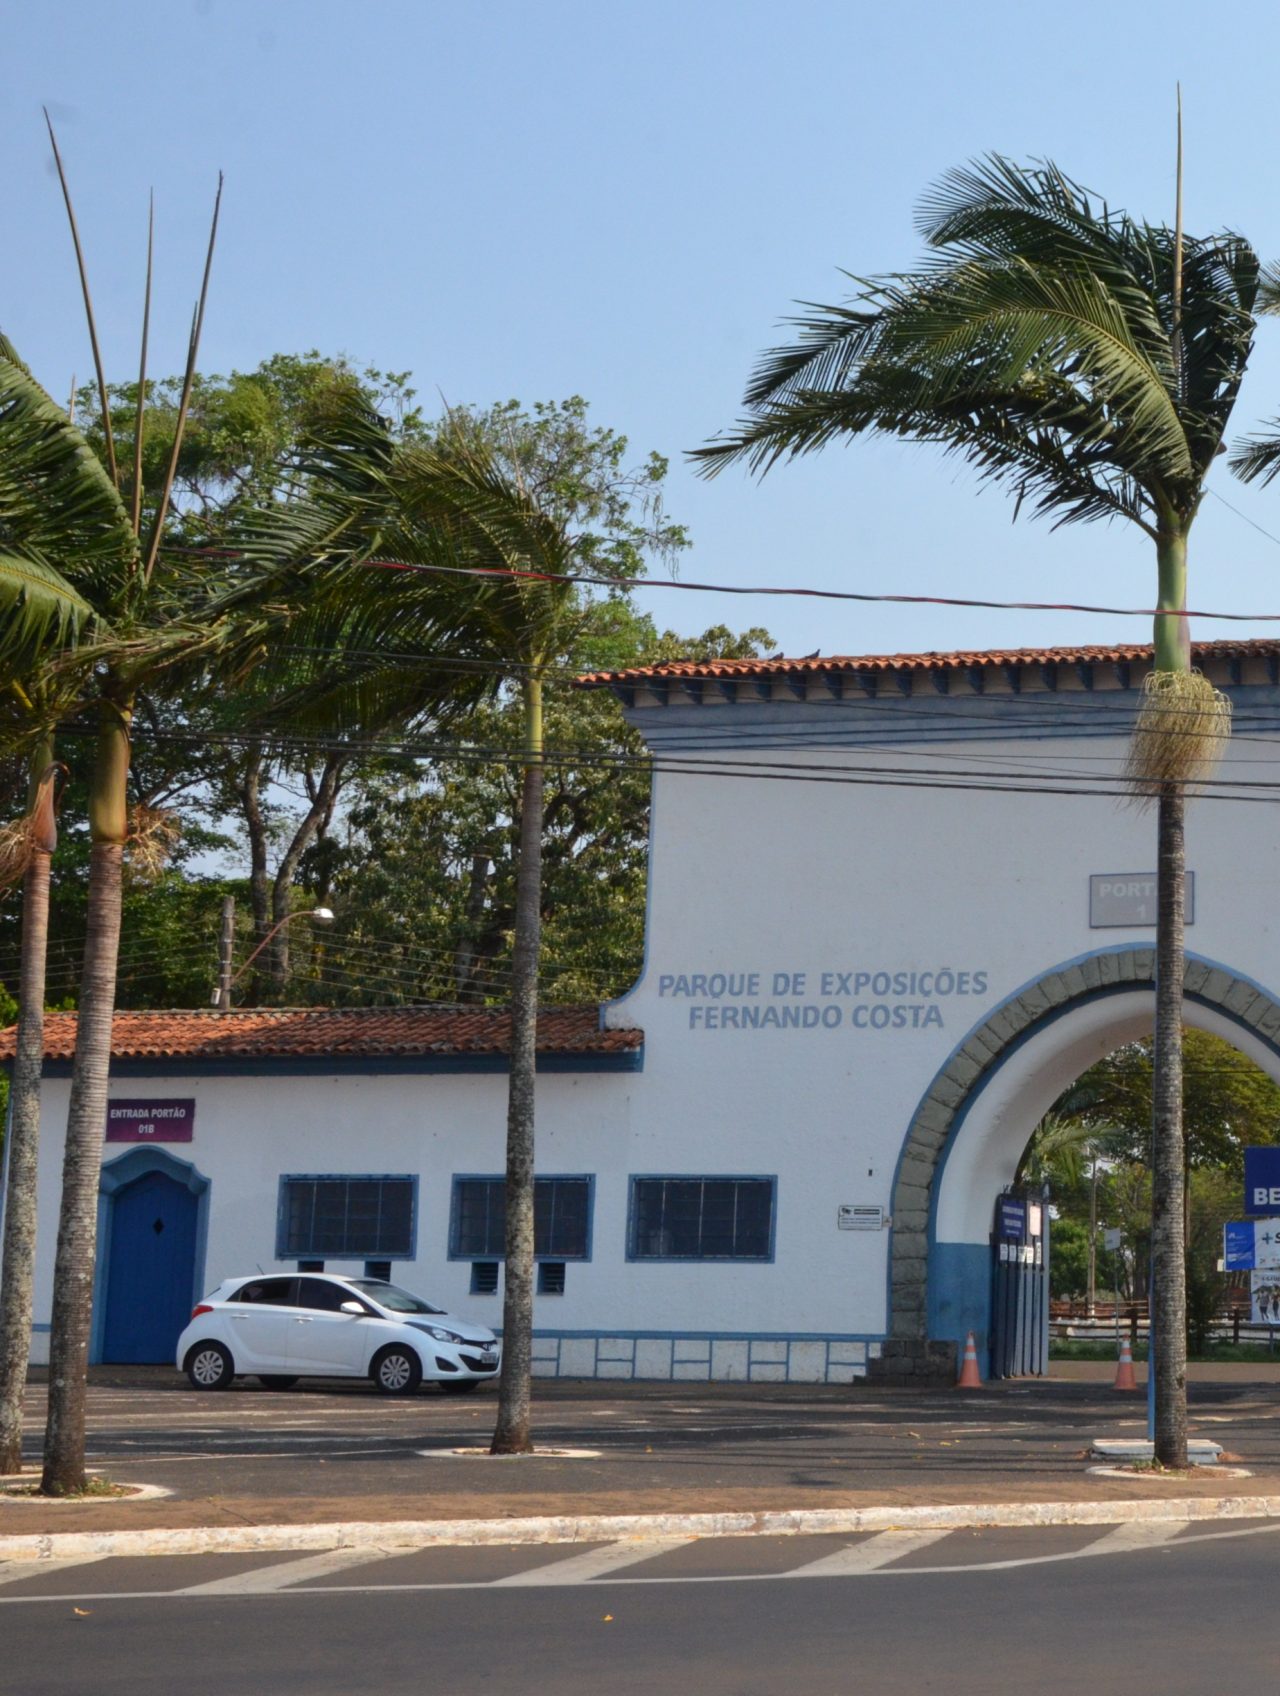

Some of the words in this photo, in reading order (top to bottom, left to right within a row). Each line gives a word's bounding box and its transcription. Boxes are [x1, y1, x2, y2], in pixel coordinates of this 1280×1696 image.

[657, 973, 760, 999] PARQUE
[771, 973, 806, 996] DE
[820, 967, 988, 998] EXPOSIÇÕES
[689, 1005, 842, 1029] FERNANDO
[851, 1004, 945, 1029] COSTA
[110, 1108, 149, 1119] ENTRADA
[151, 1107, 186, 1118] PORTÃO
[138, 1124, 155, 1134] 01B
